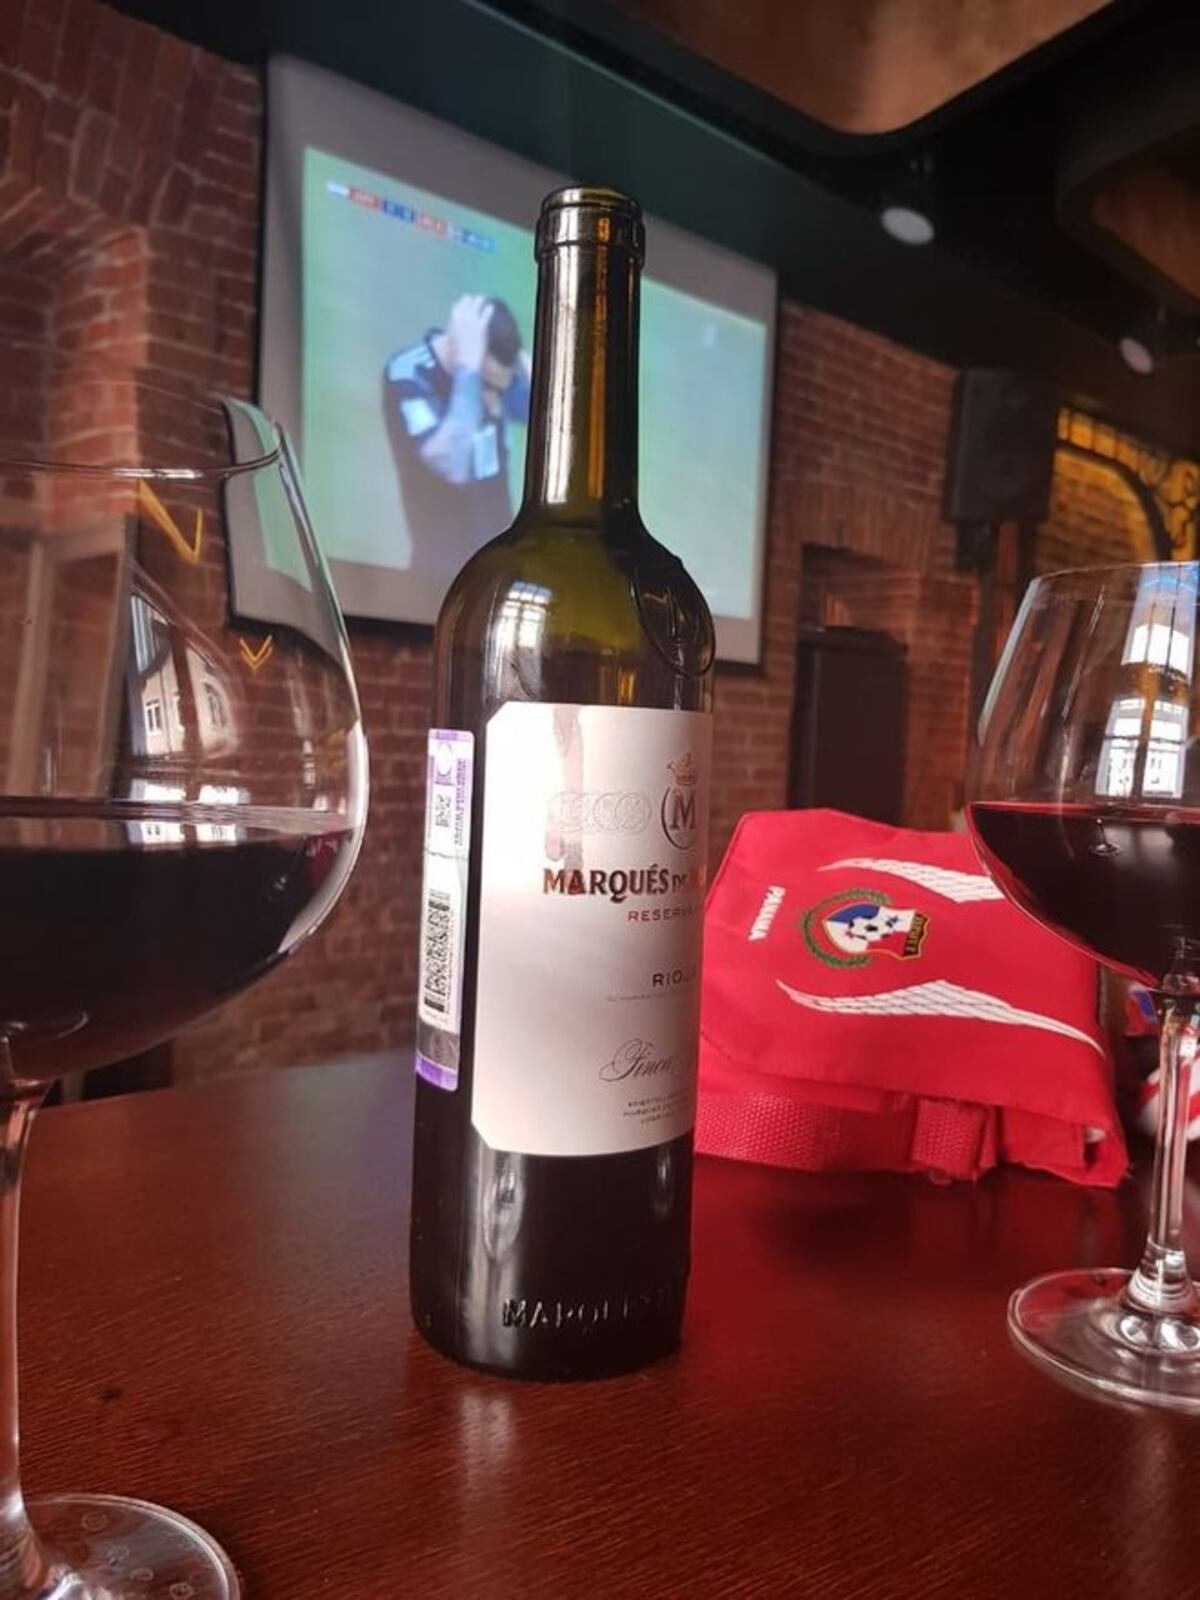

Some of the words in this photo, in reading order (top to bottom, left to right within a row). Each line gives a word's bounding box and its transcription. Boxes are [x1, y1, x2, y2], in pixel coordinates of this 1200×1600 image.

[543, 864, 669, 904] MARQUÉS
[747, 885, 786, 941] PANAMA
[652, 968, 697, 988] RIO
